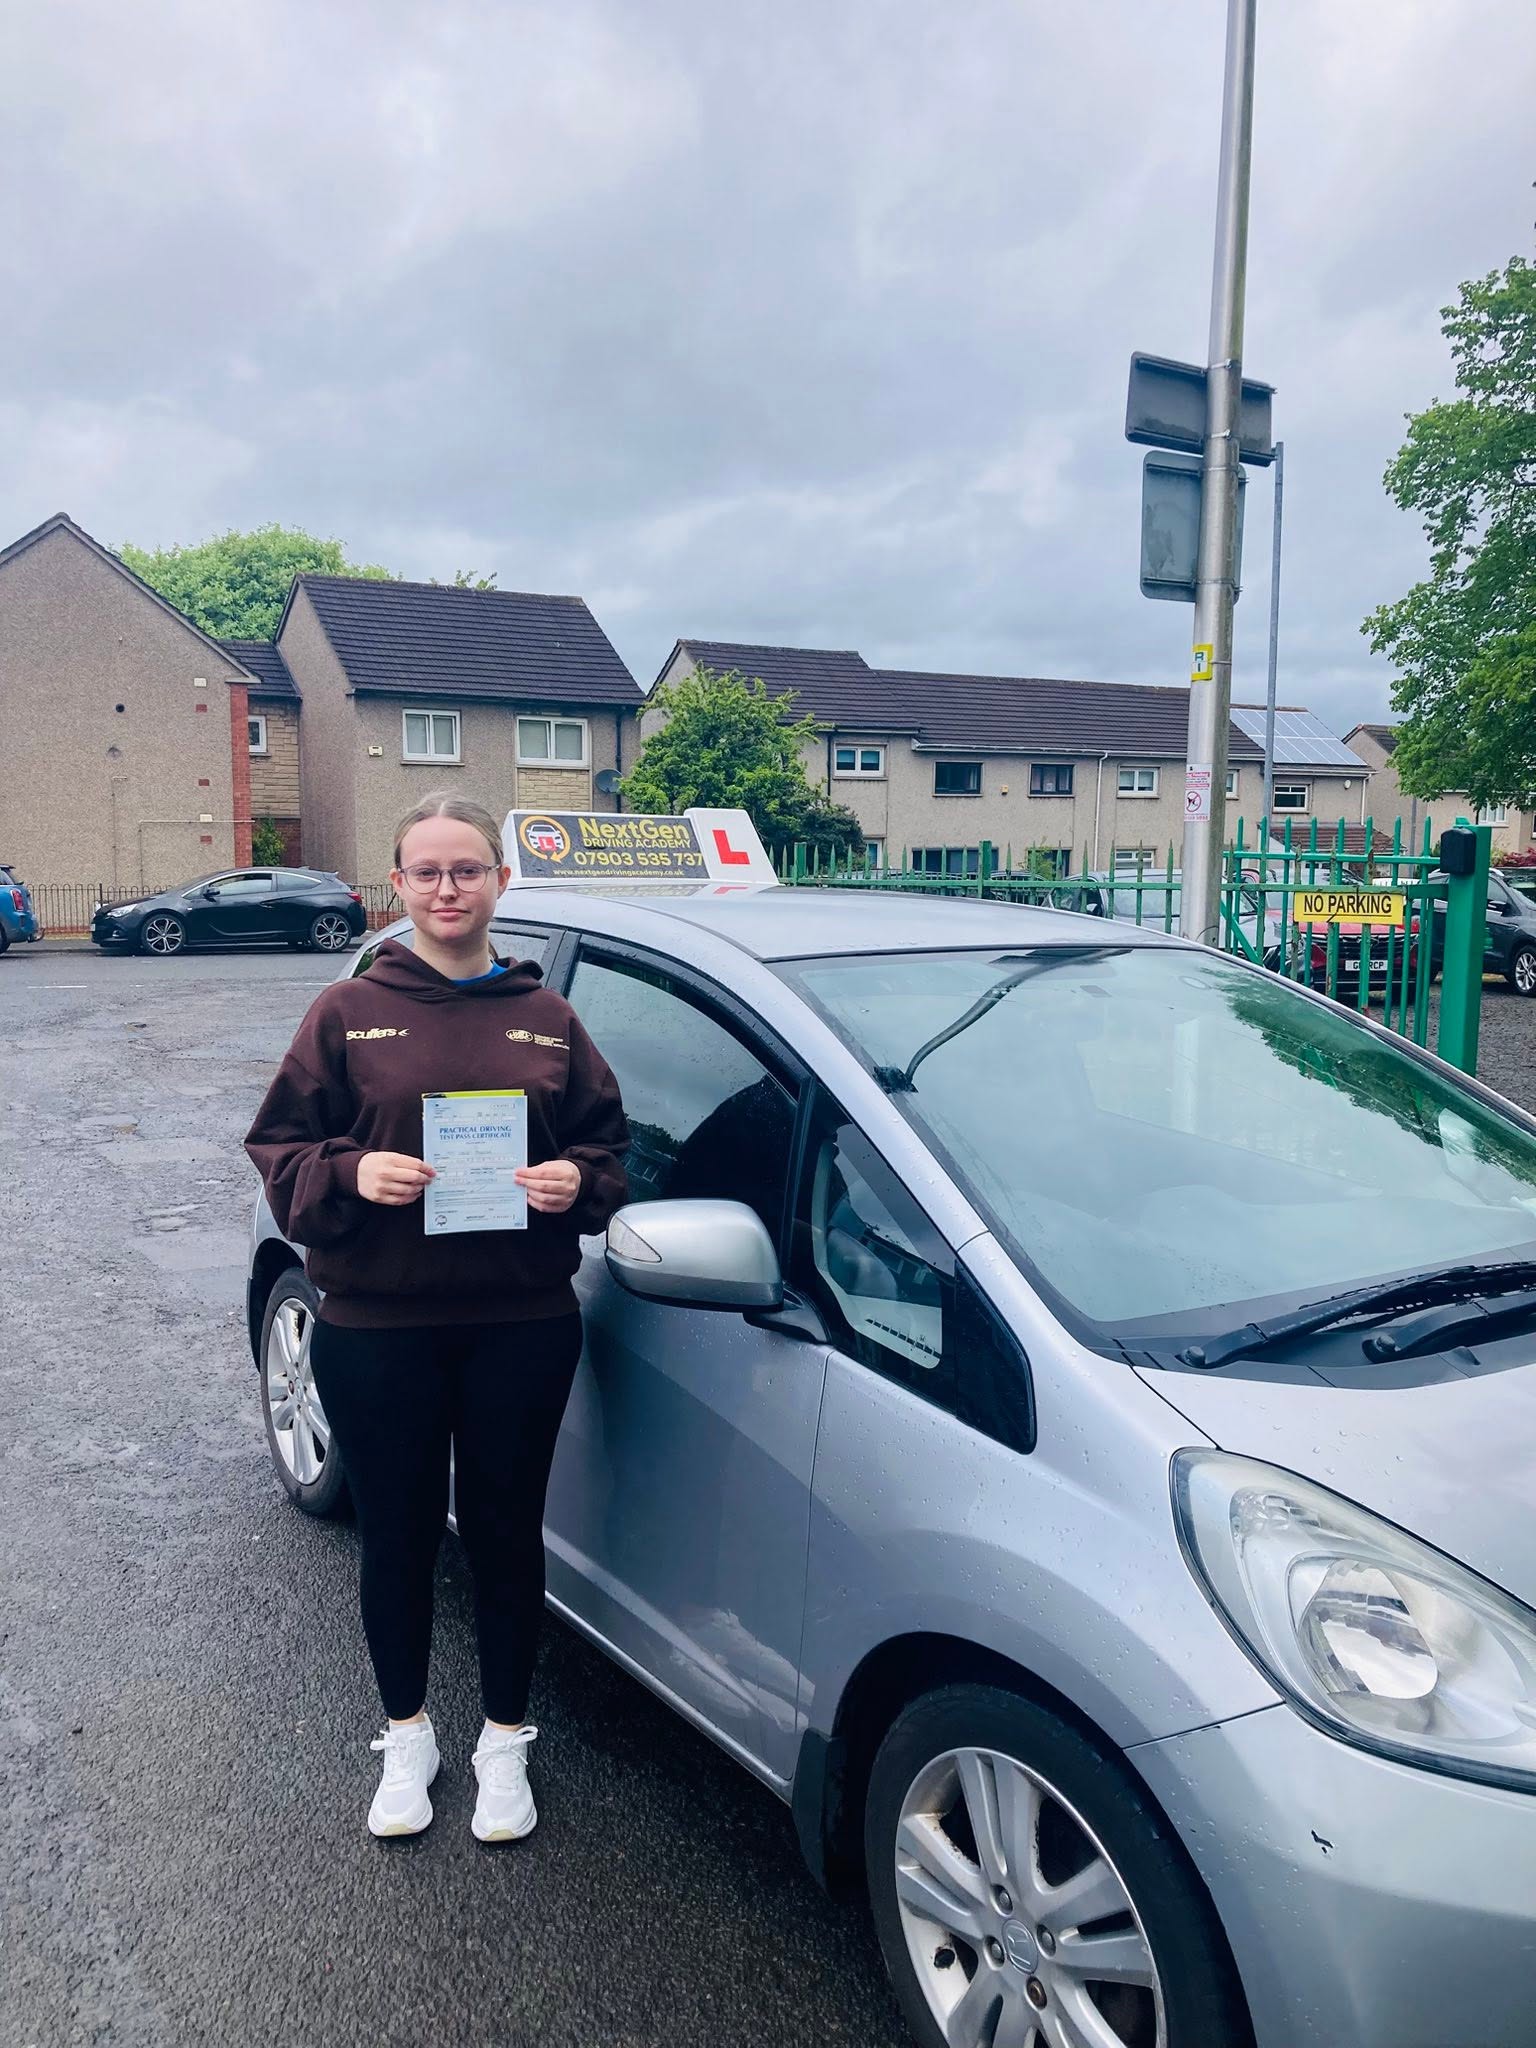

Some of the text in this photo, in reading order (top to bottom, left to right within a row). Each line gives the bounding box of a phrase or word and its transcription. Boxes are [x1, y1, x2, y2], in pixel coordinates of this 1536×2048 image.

[1194, 651, 1204, 661] R
[578, 817, 690, 840] NextGen
[542, 838, 553, 849] L
[583, 838, 691, 849] DRIVING ACADEMY
[711, 829, 751, 865] L
[574, 852, 703, 867] 07903 535 737
[1304, 895, 1392, 914] NO PARKING
[440, 1126, 478, 1134] PRACTICAL
